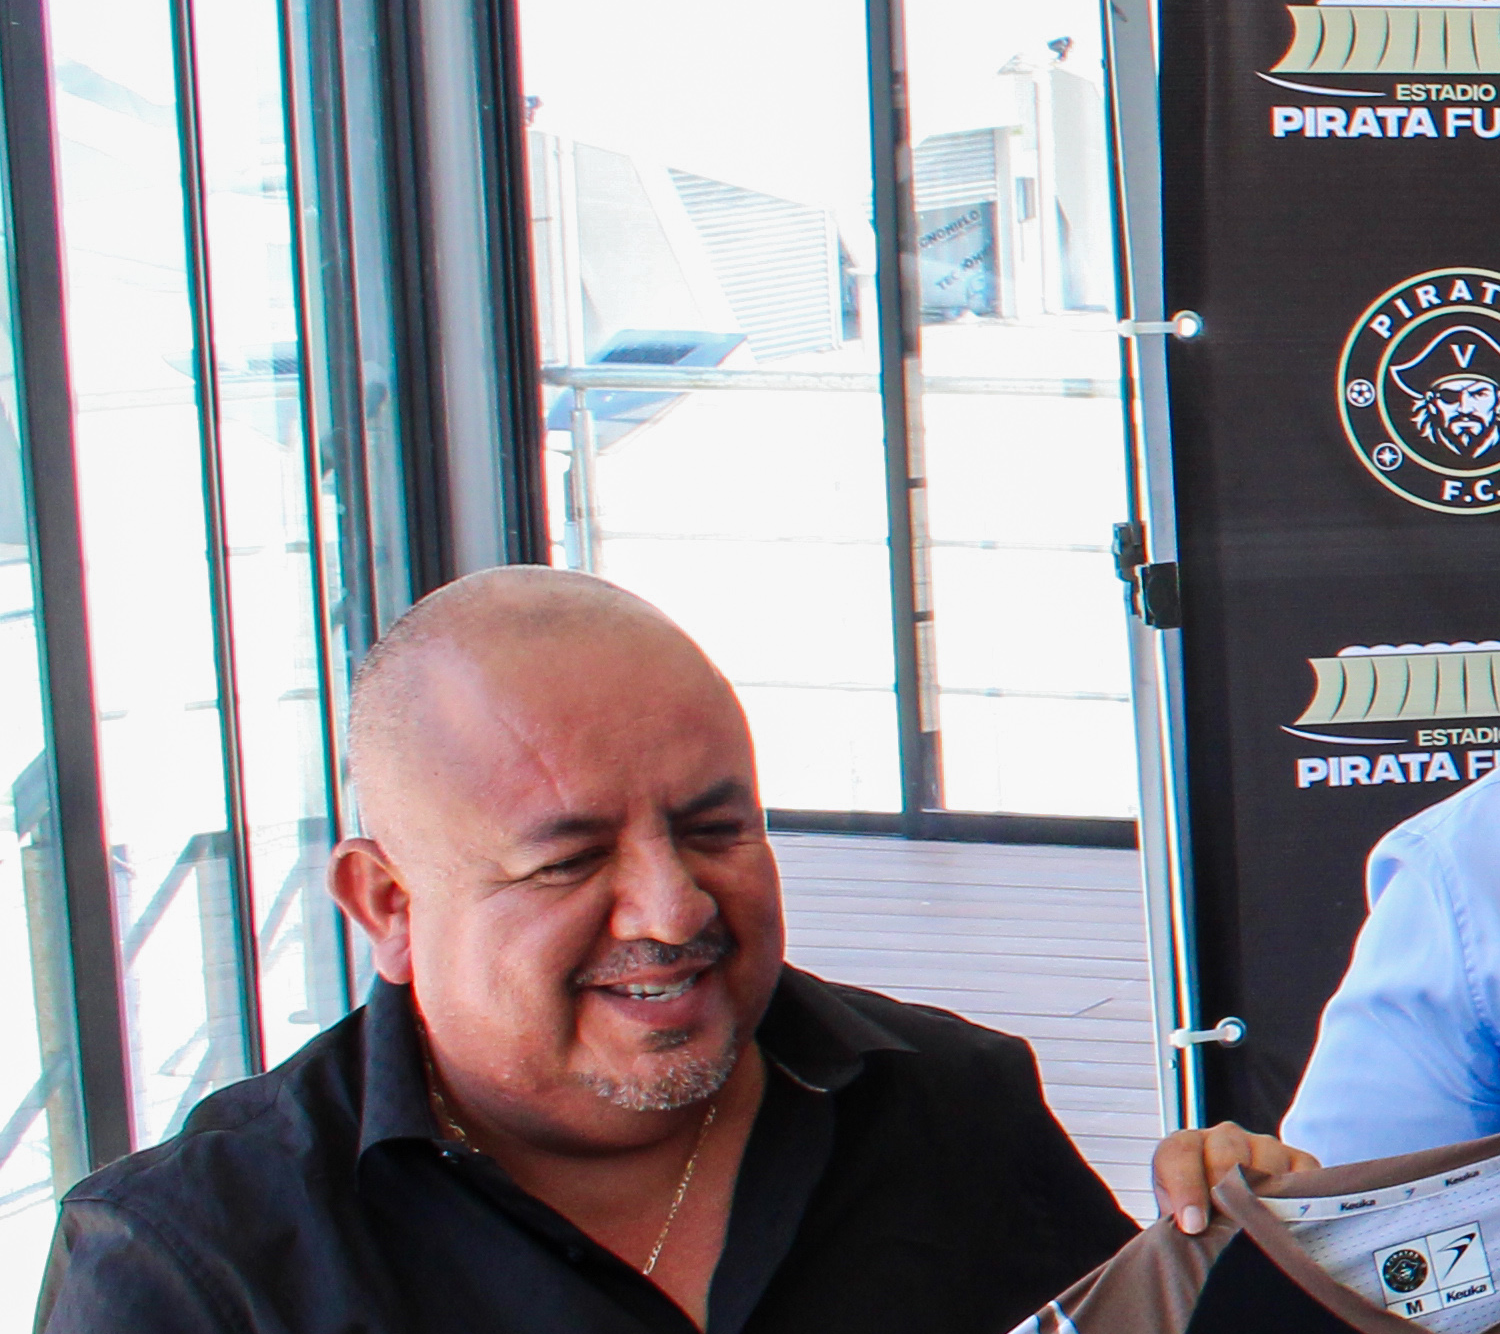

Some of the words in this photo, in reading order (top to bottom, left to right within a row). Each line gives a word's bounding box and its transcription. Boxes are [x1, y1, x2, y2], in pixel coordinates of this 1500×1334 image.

[1396, 83, 1496, 102] ESTADIO
[1273, 106, 1438, 138] PIRATA
[1295, 750, 1460, 789] PIRATA
[1445, 1170, 1480, 1186] Keuka
[1340, 1197, 1376, 1211] Keuka
[1446, 1283, 1488, 1304] Keuka
[1405, 1299, 1424, 1315] M
